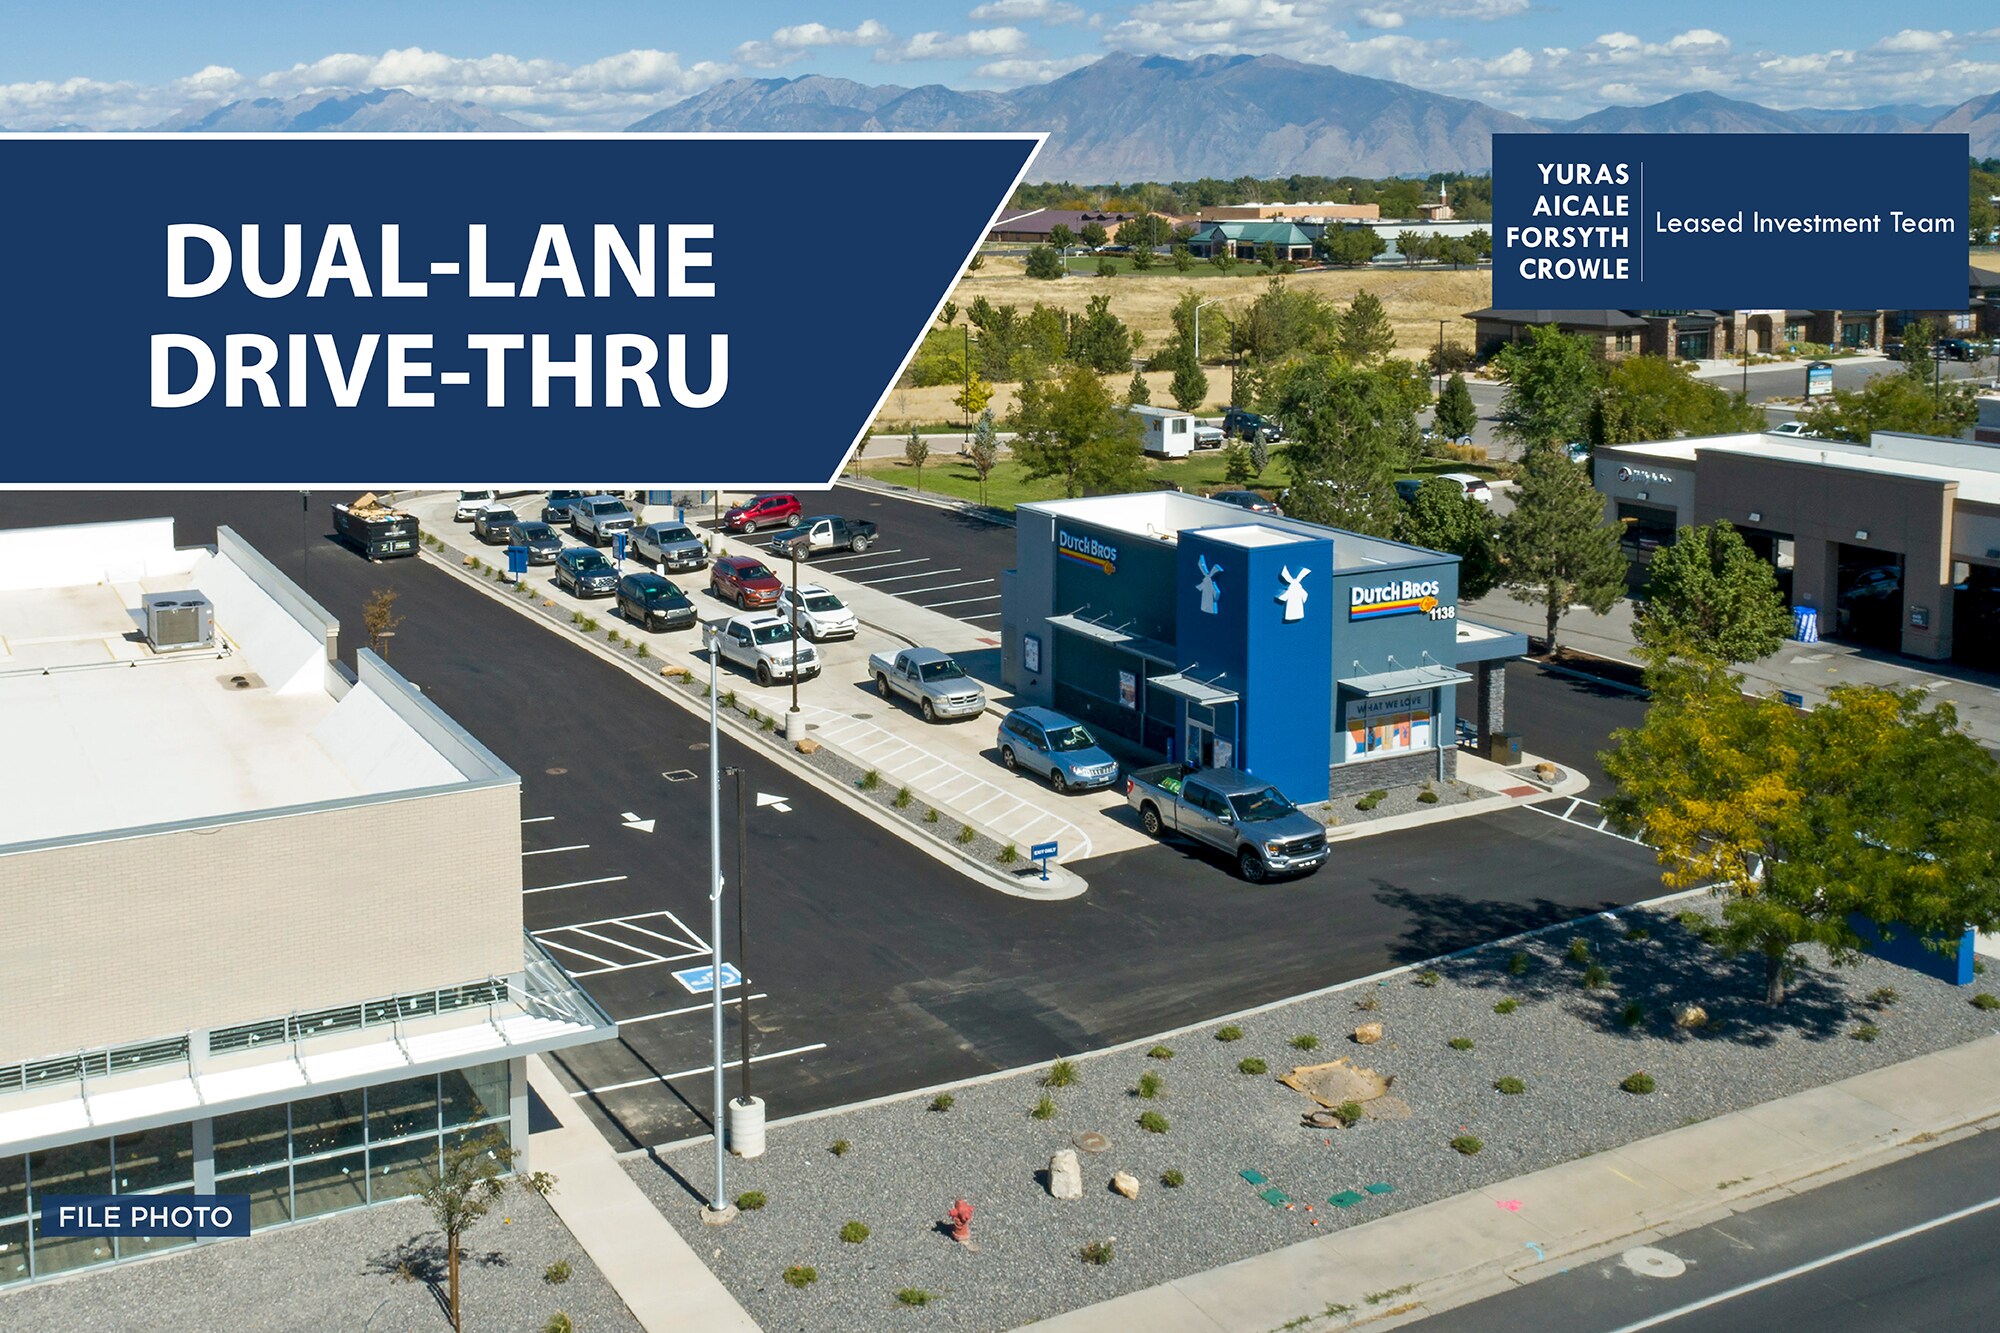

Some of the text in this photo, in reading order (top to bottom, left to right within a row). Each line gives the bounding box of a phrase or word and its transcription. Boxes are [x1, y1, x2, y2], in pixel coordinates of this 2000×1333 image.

[1091, 539, 1117, 561] BROS
[1351, 582, 1400, 605] DUTCH
[1401, 580, 1440, 599] BROS
[1429, 606, 1455, 621] 1138
[1357, 696, 1422, 714] WHAT WE LOVE
